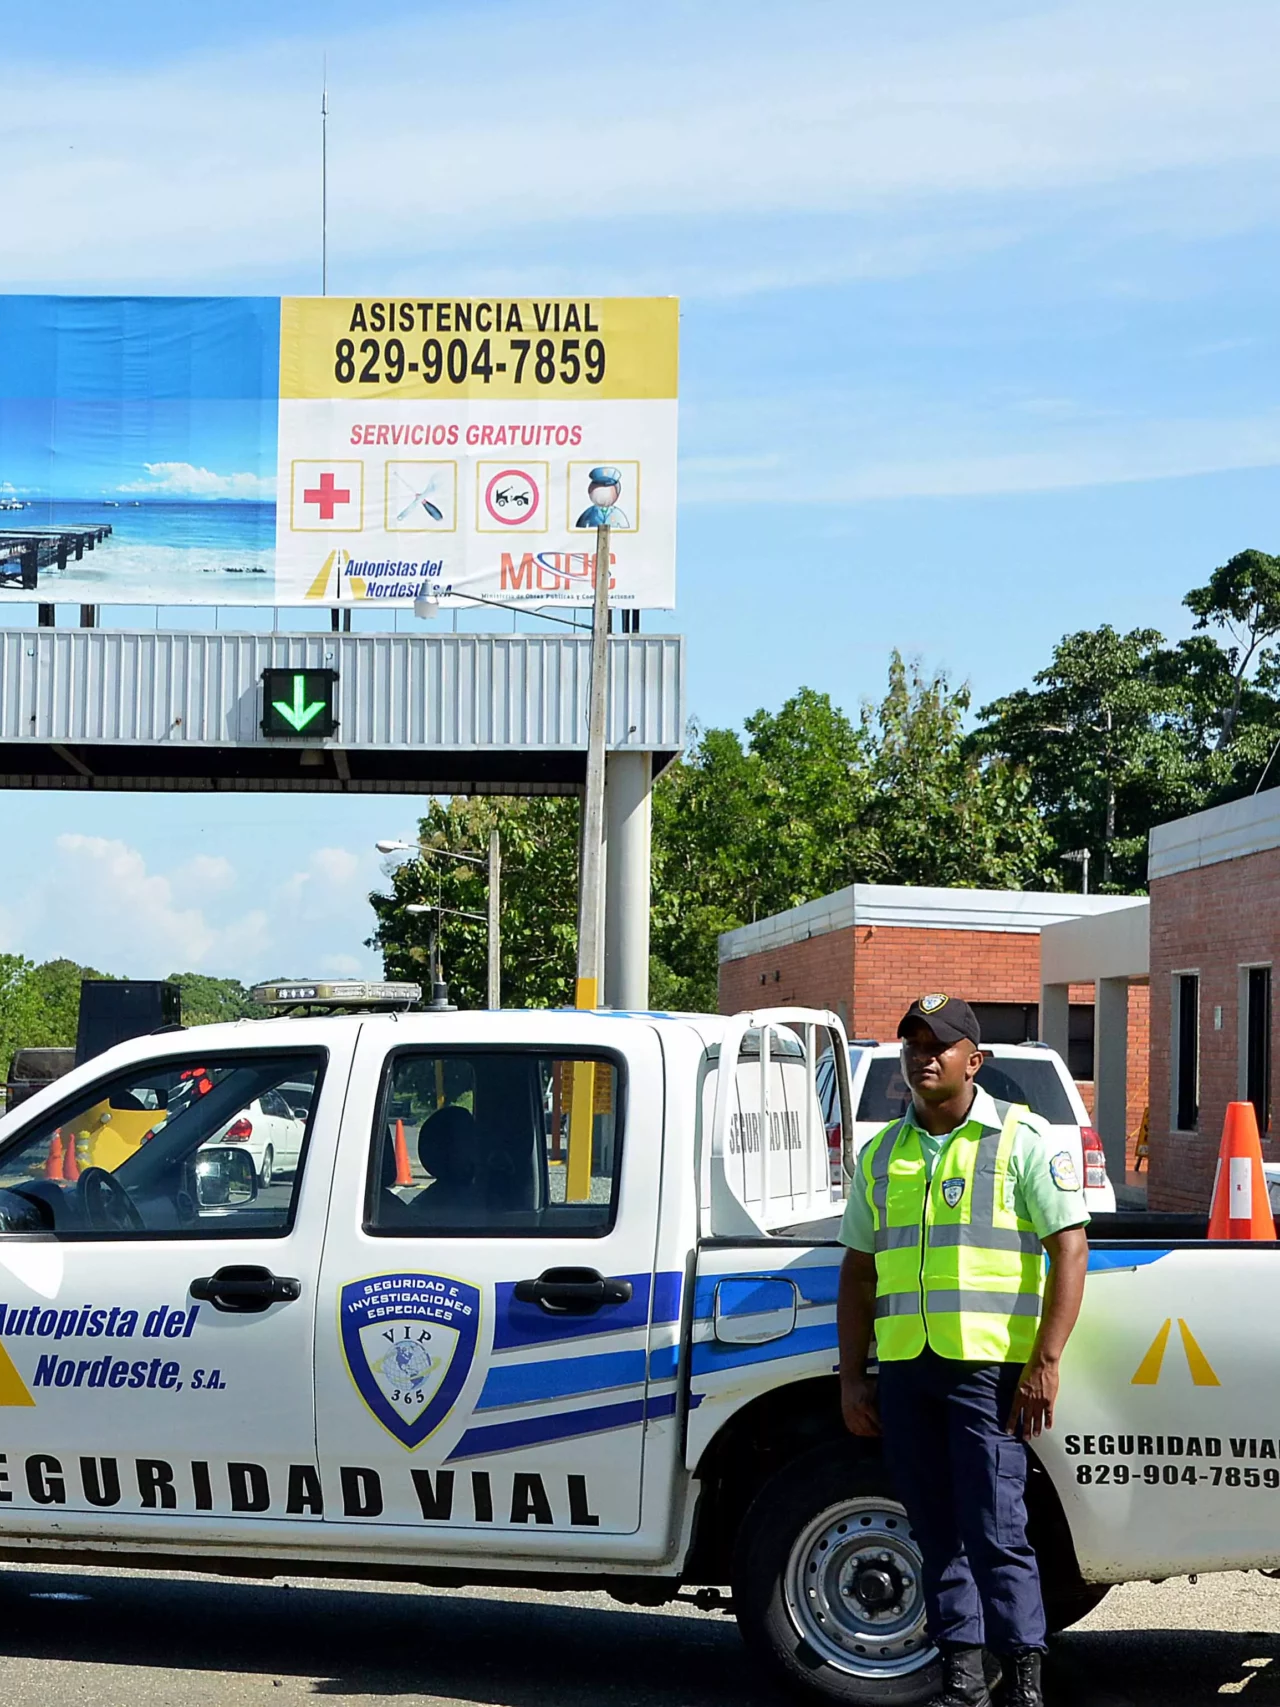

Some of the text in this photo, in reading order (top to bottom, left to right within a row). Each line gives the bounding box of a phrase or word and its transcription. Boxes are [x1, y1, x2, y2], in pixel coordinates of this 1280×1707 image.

[349, 302, 599, 333] ASISTENCIA VIAL
[334, 337, 606, 385] 829-904-7859
[350, 424, 583, 446] SERVICIOS GRATUITOS
[344, 559, 443, 578] Autopistas del
[366, 581, 426, 598] Nordest
[729, 1111, 781, 1155] SEGURAD
[363, 1279, 459, 1297] SEGURIDAD E
[348, 1293, 472, 1316] INVESTIGACIONES
[367, 1305, 453, 1321] ESPECIALES
[142, 1304, 200, 1340] del
[33, 1354, 227, 1392] Nordeste, S.A.
[391, 1389, 424, 1404] 365
[1064, 1434, 1280, 1459] SEGURIDAD VIA
[1076, 1464, 1280, 1489] 829-904-7859
[410, 1468, 600, 1527] VIAL
